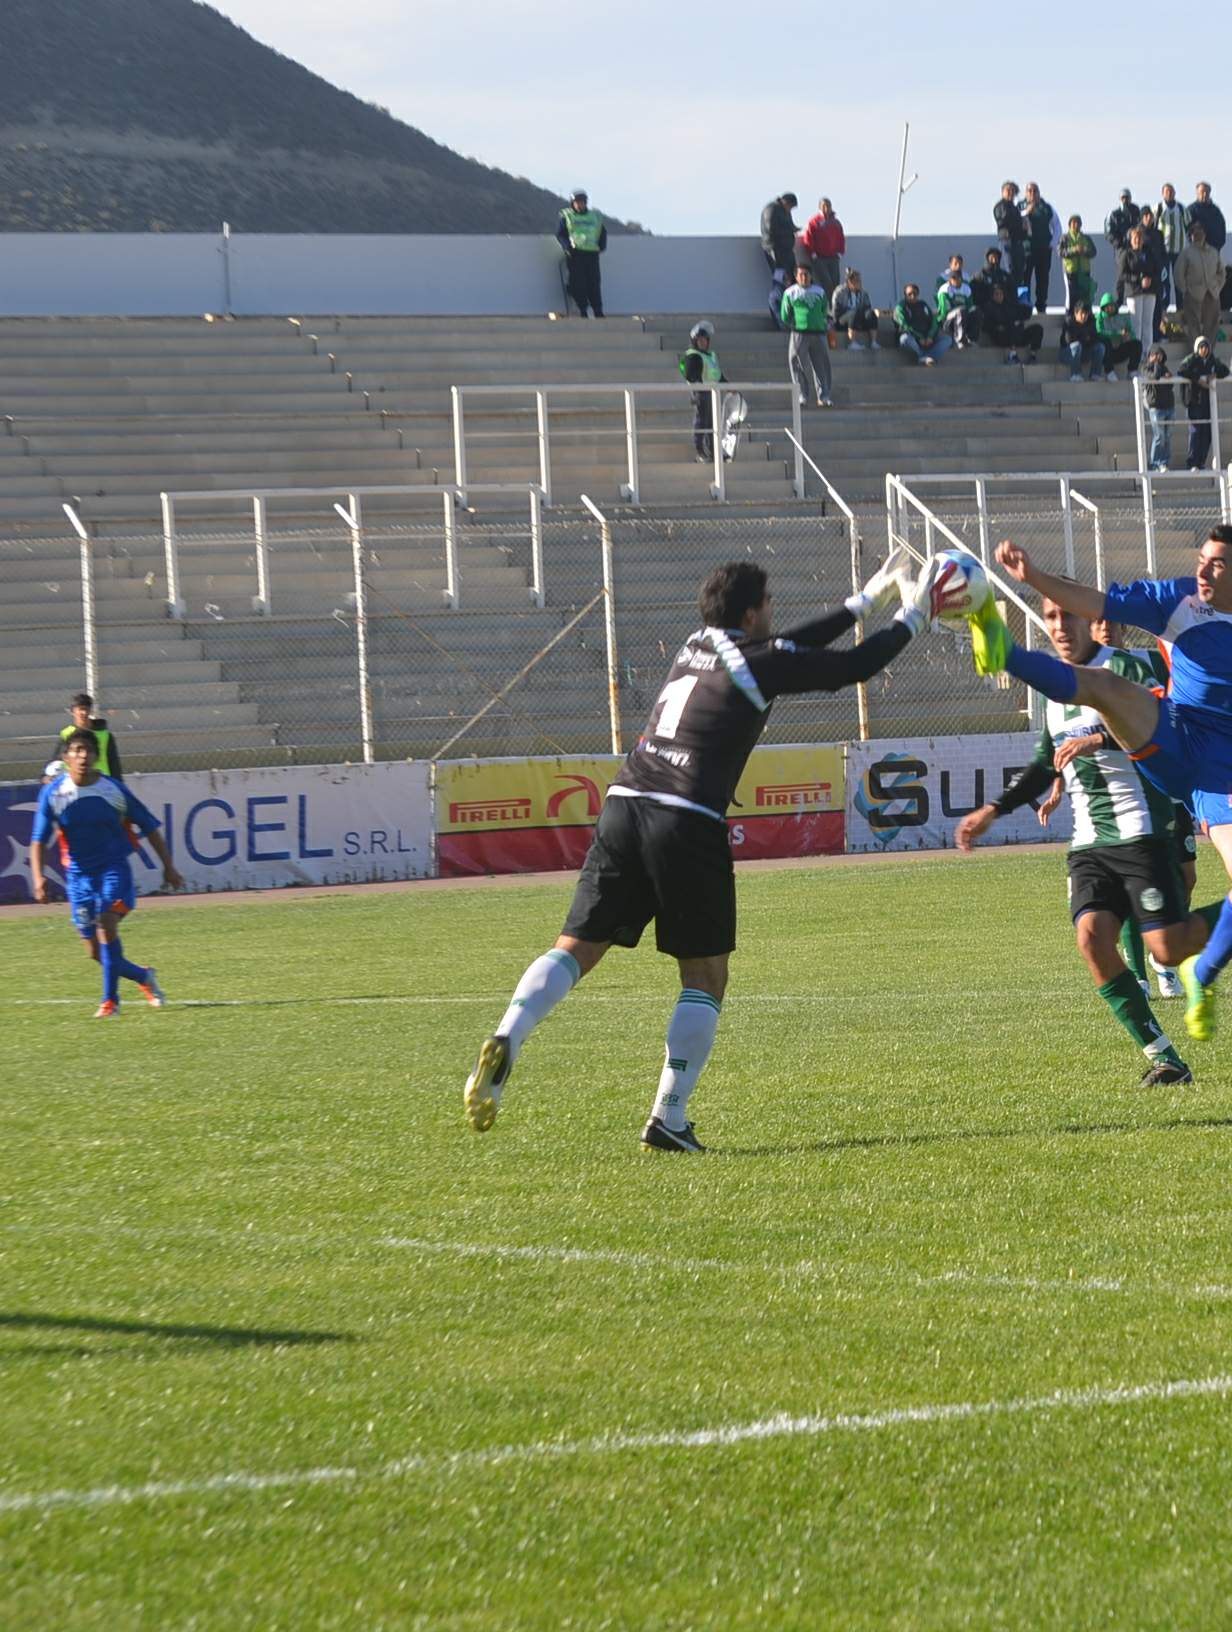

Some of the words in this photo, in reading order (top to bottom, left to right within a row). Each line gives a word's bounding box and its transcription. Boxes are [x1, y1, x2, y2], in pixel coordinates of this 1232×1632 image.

[655, 674, 699, 739] 1
[755, 783, 832, 806] PIRELLI
[449, 798, 532, 824] PIRELLI
[344, 830, 418, 855] S.R.L.
